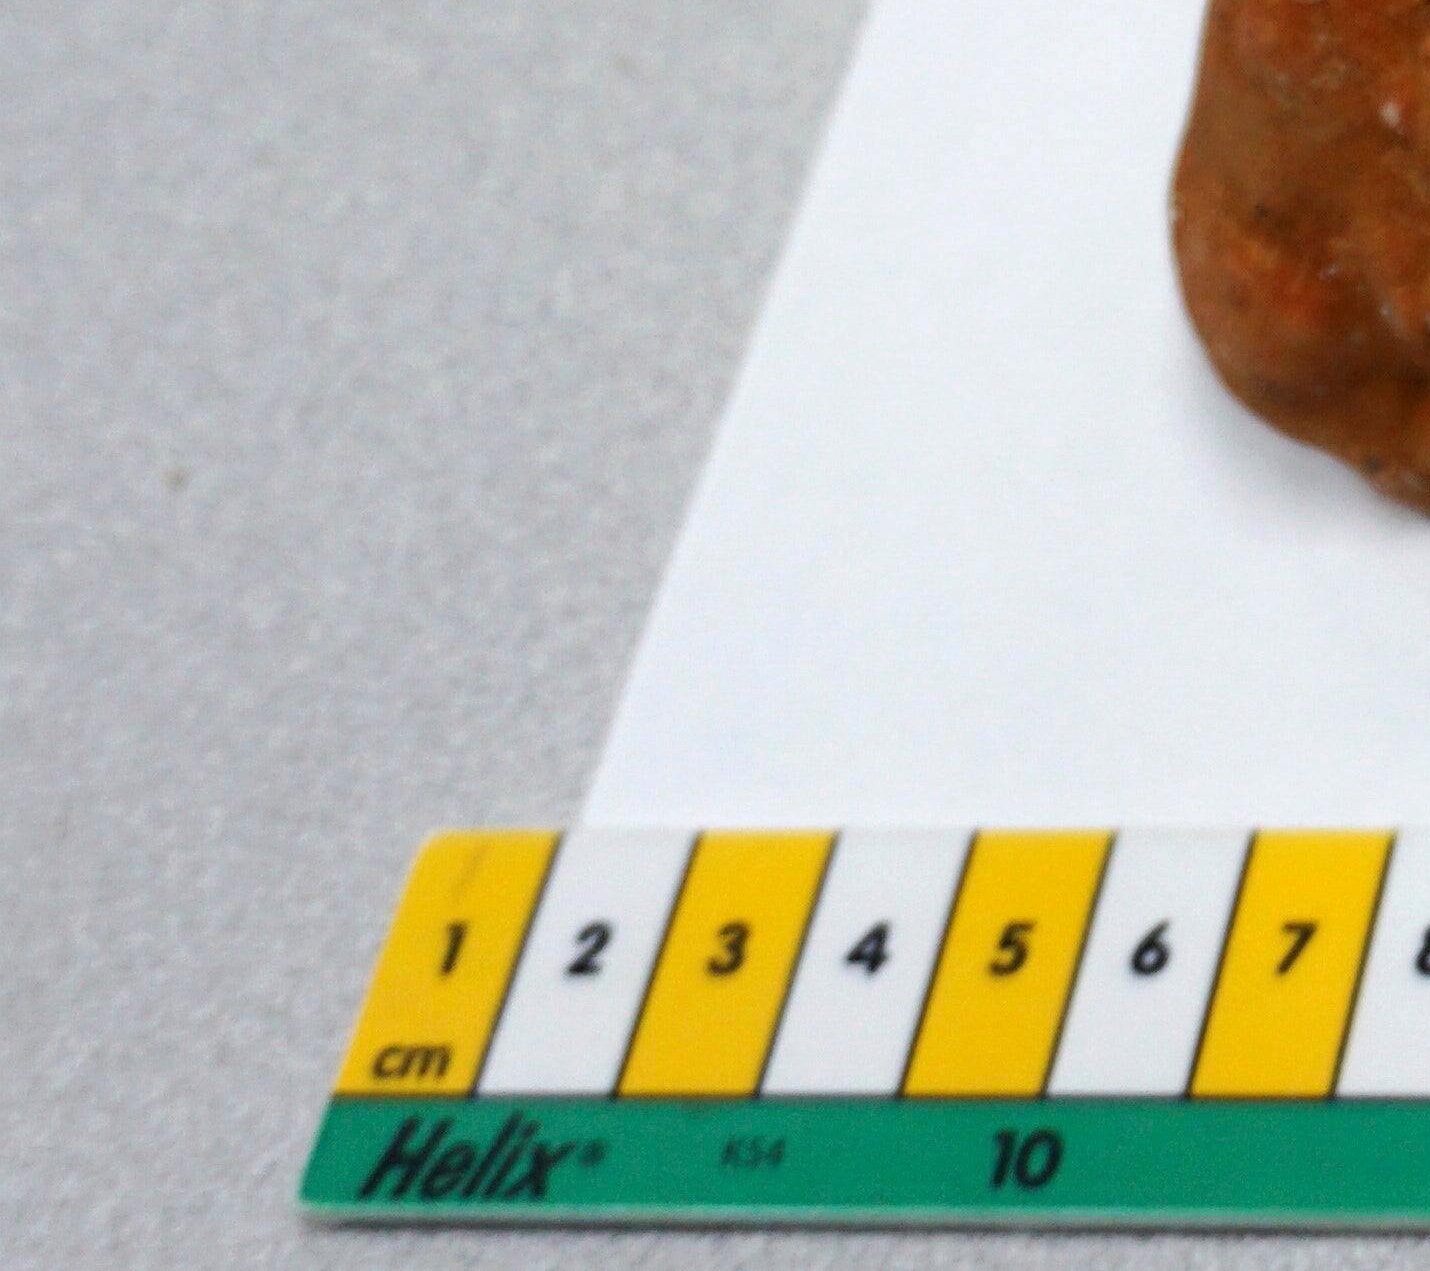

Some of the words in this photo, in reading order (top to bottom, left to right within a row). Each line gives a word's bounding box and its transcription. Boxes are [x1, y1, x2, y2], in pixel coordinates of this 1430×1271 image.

[442, 923, 466, 974] 1
[567, 922, 612, 977] 2
[707, 923, 749, 977] 3
[845, 923, 889, 974] 4
[990, 923, 1032, 977] 5
[1130, 922, 1170, 977] 6
[1278, 923, 1316, 975] 7
[370, 1042, 453, 1080] cm
[355, 1110, 577, 1201] Helix
[987, 1126, 1066, 1193] 10
